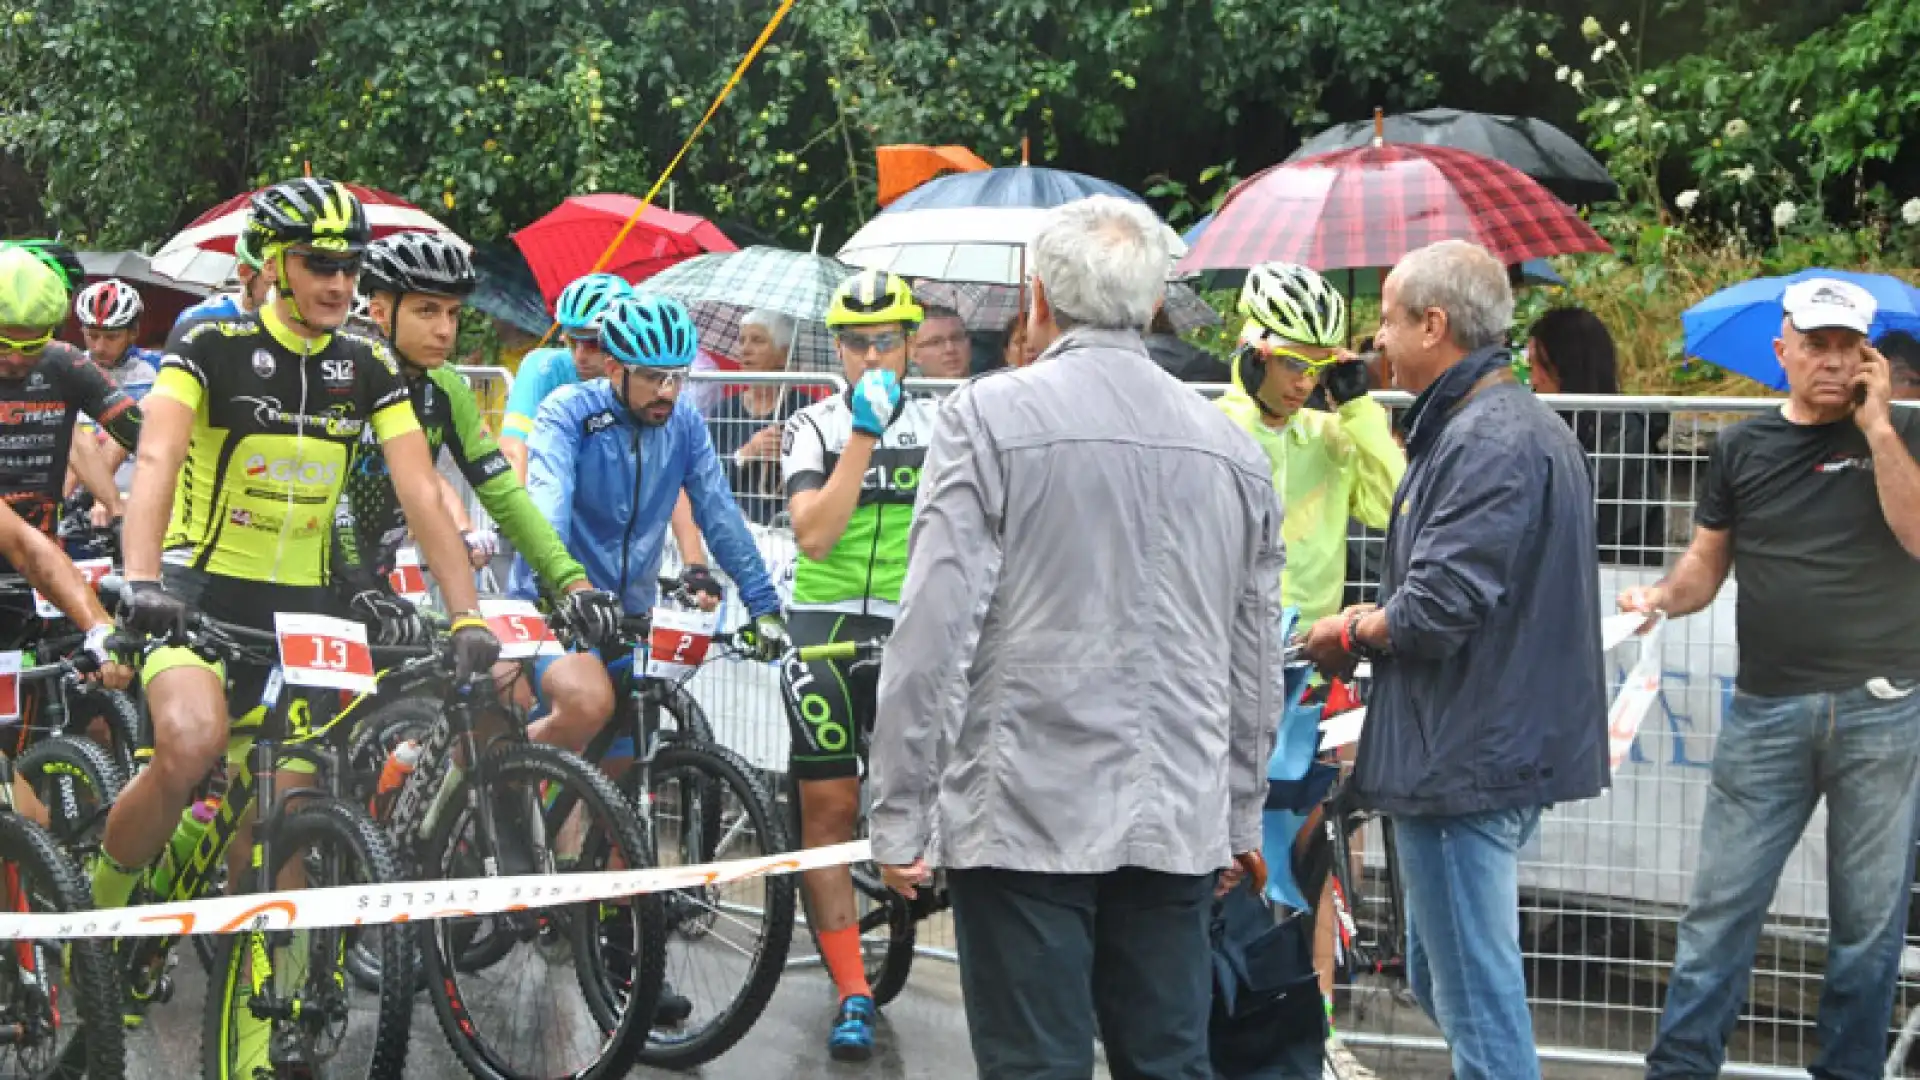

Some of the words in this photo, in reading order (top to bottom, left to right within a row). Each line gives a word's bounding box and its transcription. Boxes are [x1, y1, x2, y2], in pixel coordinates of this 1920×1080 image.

[508, 616, 530, 640] 5
[309, 637, 348, 669] 13
[673, 635, 692, 661] 2
[358, 889, 480, 909] CYCLES
